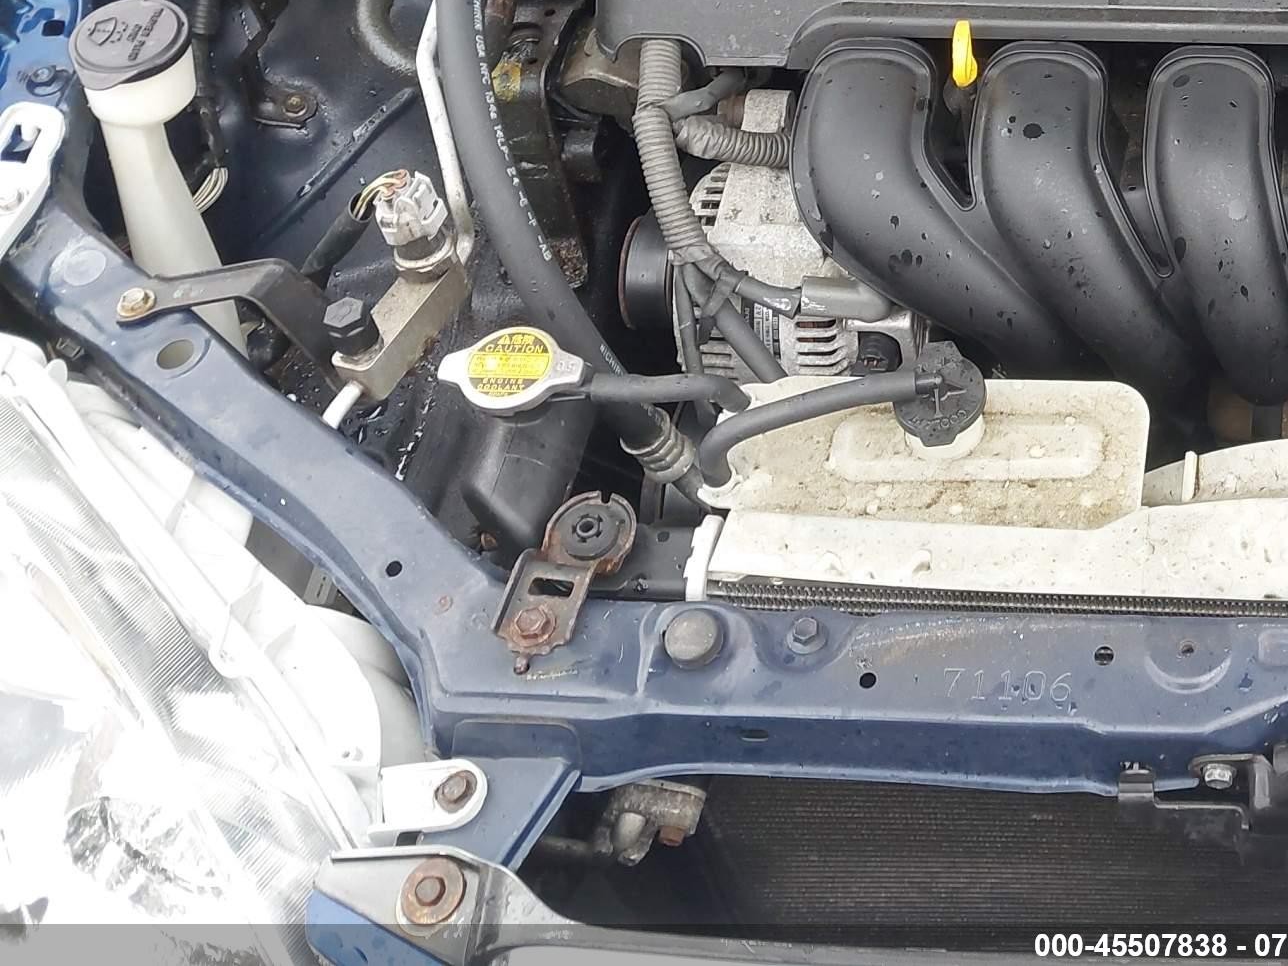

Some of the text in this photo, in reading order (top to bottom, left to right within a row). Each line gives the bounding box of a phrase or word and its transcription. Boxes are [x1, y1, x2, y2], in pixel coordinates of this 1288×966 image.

[485, 344, 544, 353] CAUTION
[477, 383, 526, 391] COOLANT
[943, 666, 1073, 703] 71106
